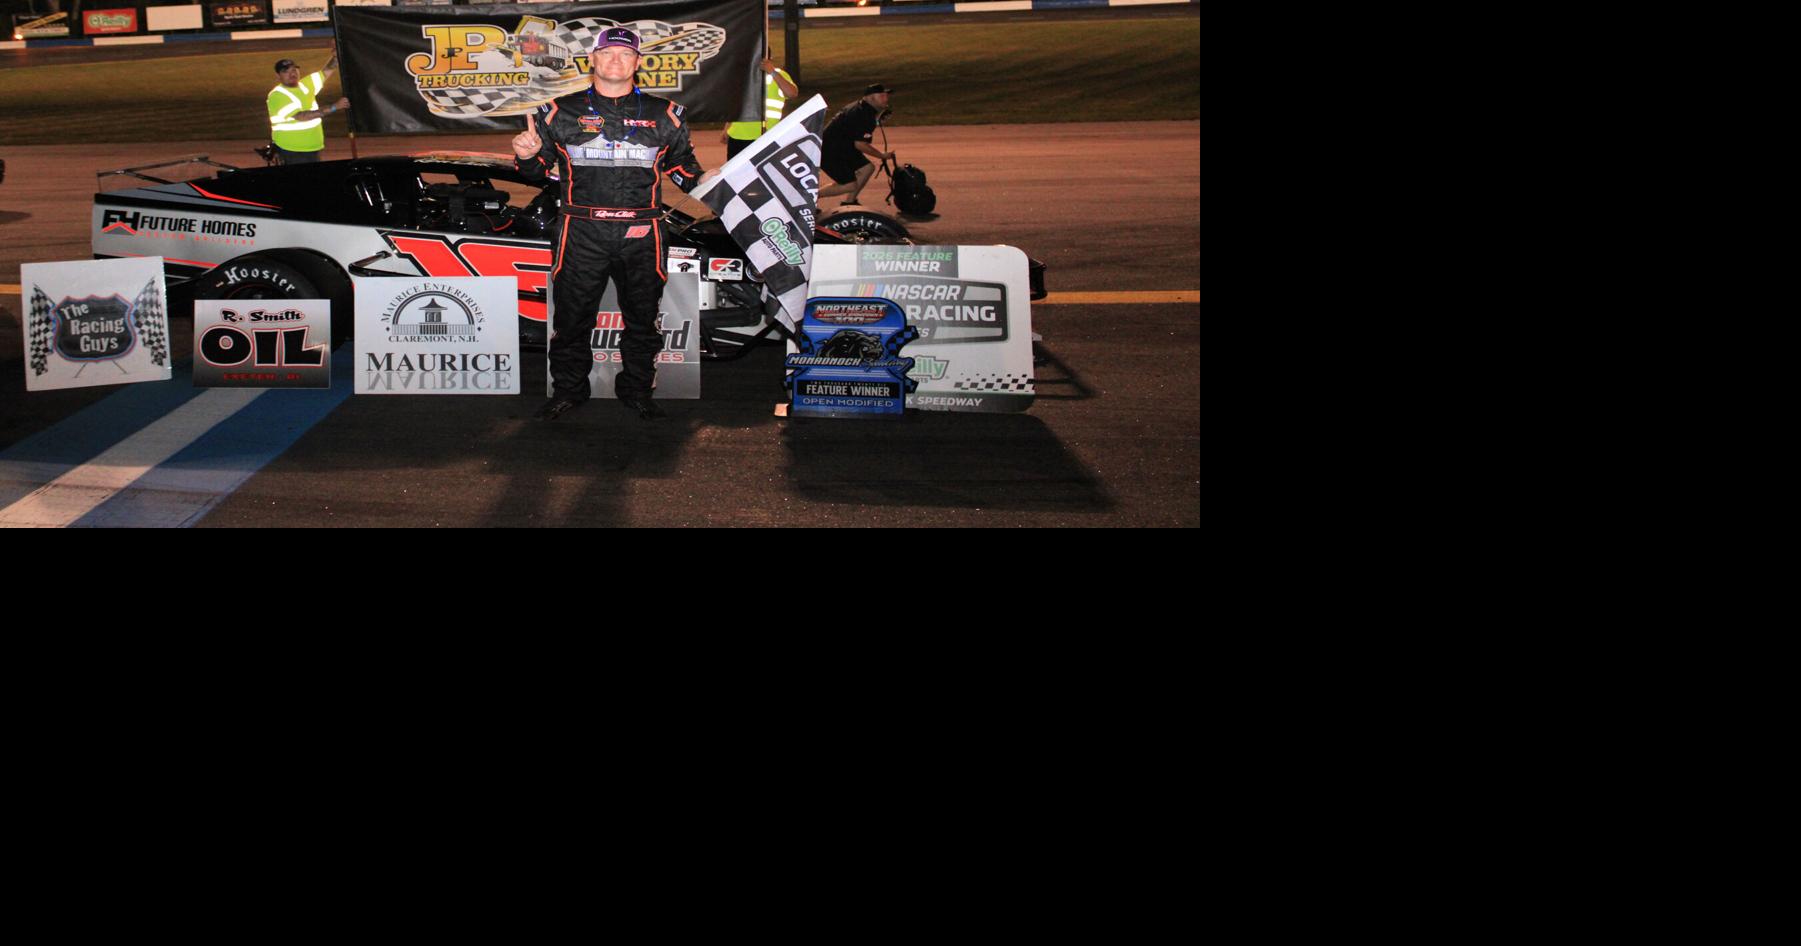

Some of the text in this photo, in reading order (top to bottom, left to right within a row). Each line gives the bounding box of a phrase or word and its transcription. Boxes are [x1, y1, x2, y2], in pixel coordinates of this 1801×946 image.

[418, 72, 529, 88] TRUCKING
[140, 215, 257, 238] FUTURE HOMES
[824, 215, 883, 231] oosier
[897, 252, 953, 261] FEATURE
[874, 260, 941, 272] WINNER
[224, 266, 296, 292] Hoosier
[881, 283, 961, 300] NASCAR
[380, 282, 486, 324] MAURICE ENTERPRISES
[60, 303, 90, 320] The
[249, 309, 304, 322] Smith
[905, 304, 996, 322] RACING
[70, 317, 125, 335] Racing
[80, 335, 119, 352] Guys
[200, 326, 326, 367] OIL
[388, 335, 480, 344] CLAREMONT, N.H.
[365, 352, 512, 372] MAURICE
[788, 356, 861, 366] MONADNOCK
[806, 384, 890, 397] FEATURE WINNER
[802, 397, 894, 408] OPEN MODIFIED
[917, 396, 984, 408] SPEEDWAY
